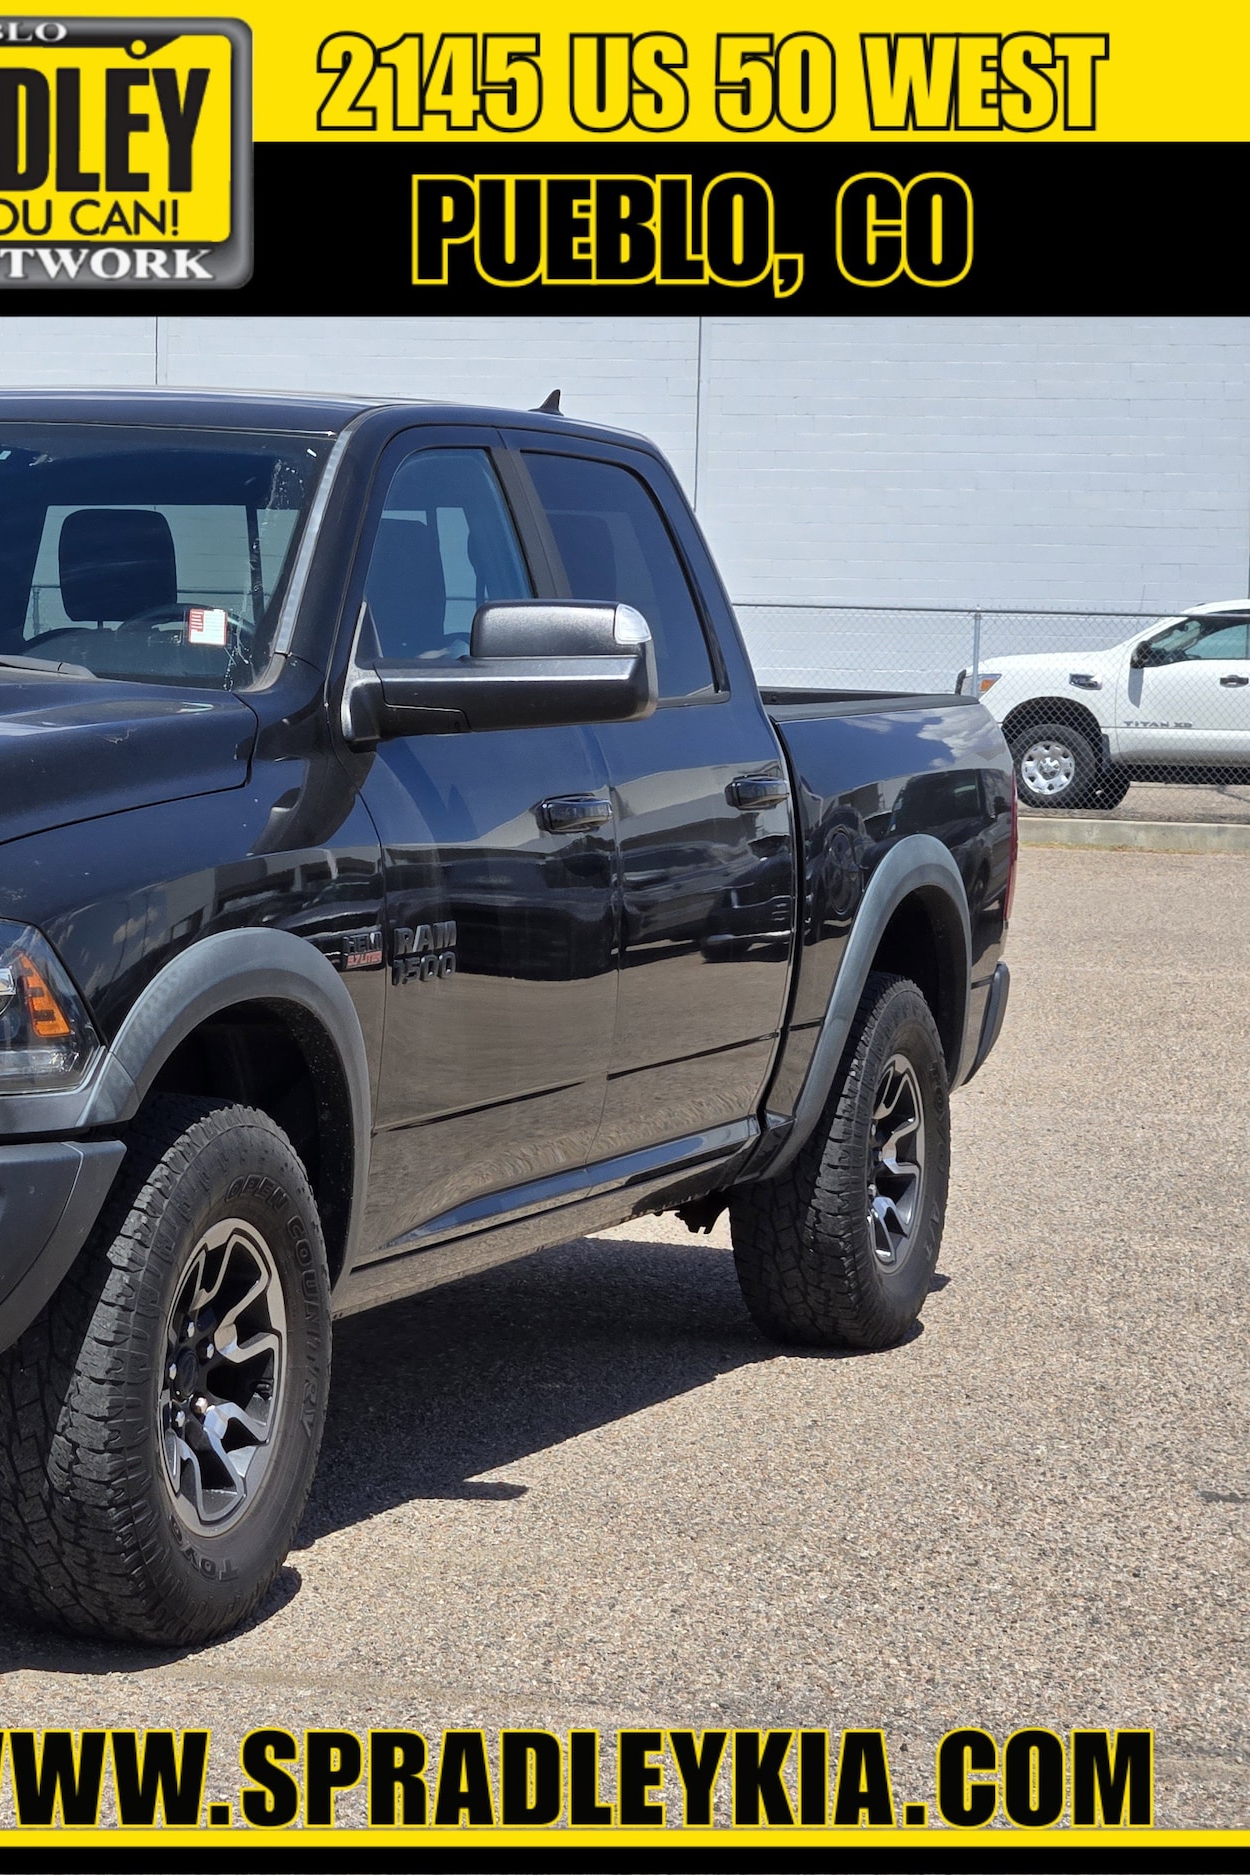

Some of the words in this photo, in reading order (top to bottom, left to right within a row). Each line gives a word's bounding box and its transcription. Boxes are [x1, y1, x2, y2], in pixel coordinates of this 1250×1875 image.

[1124, 720, 1169, 728] TITAN
[393, 920, 457, 954] RAM
[391, 951, 457, 986] 1500
[225, 1174, 289, 1213] OPEN
